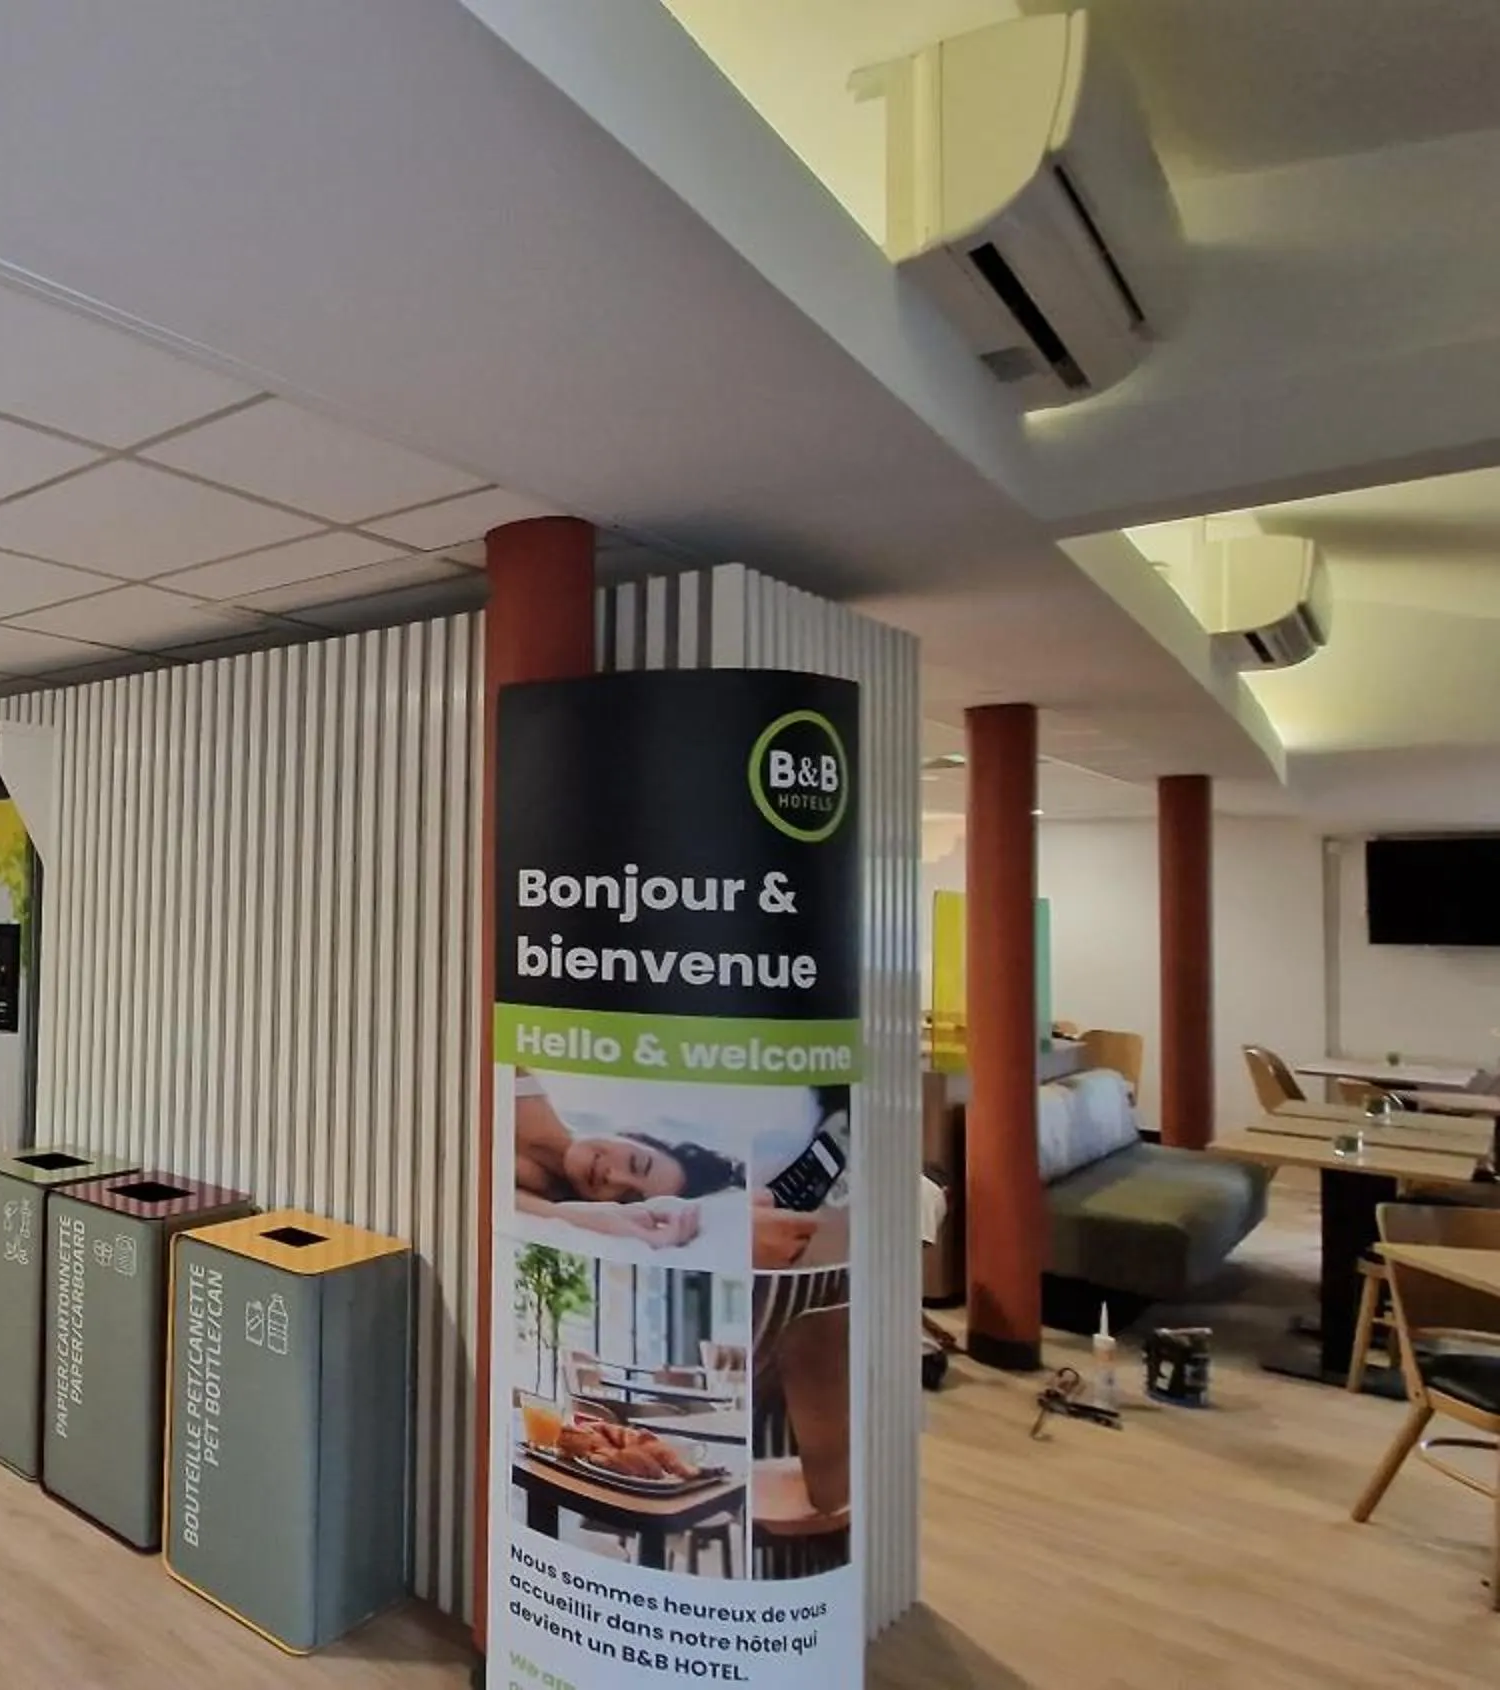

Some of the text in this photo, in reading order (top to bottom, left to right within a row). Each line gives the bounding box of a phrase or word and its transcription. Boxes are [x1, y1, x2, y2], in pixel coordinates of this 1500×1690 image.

[769, 750, 839, 792] B&B
[778, 793, 833, 811] HOTELS
[518, 863, 799, 922] Bonjour &
[517, 935, 818, 989] bienvenue
[516, 1023, 852, 1072] Hello & welcome
[56, 1215, 73, 1438] PAPIER/CARTONNETTE
[184, 1263, 205, 1547] BOUTEILLE PET/CANETTE
[203, 1269, 223, 1467] PET BOTTLE/CAN
[510, 1574, 818, 1656] accueillir dans notre hôtel qui
[511, 1543, 827, 1624] Nous sommes heureux de vous
[510, 1601, 749, 1682] devient un B&B HOTEL.
